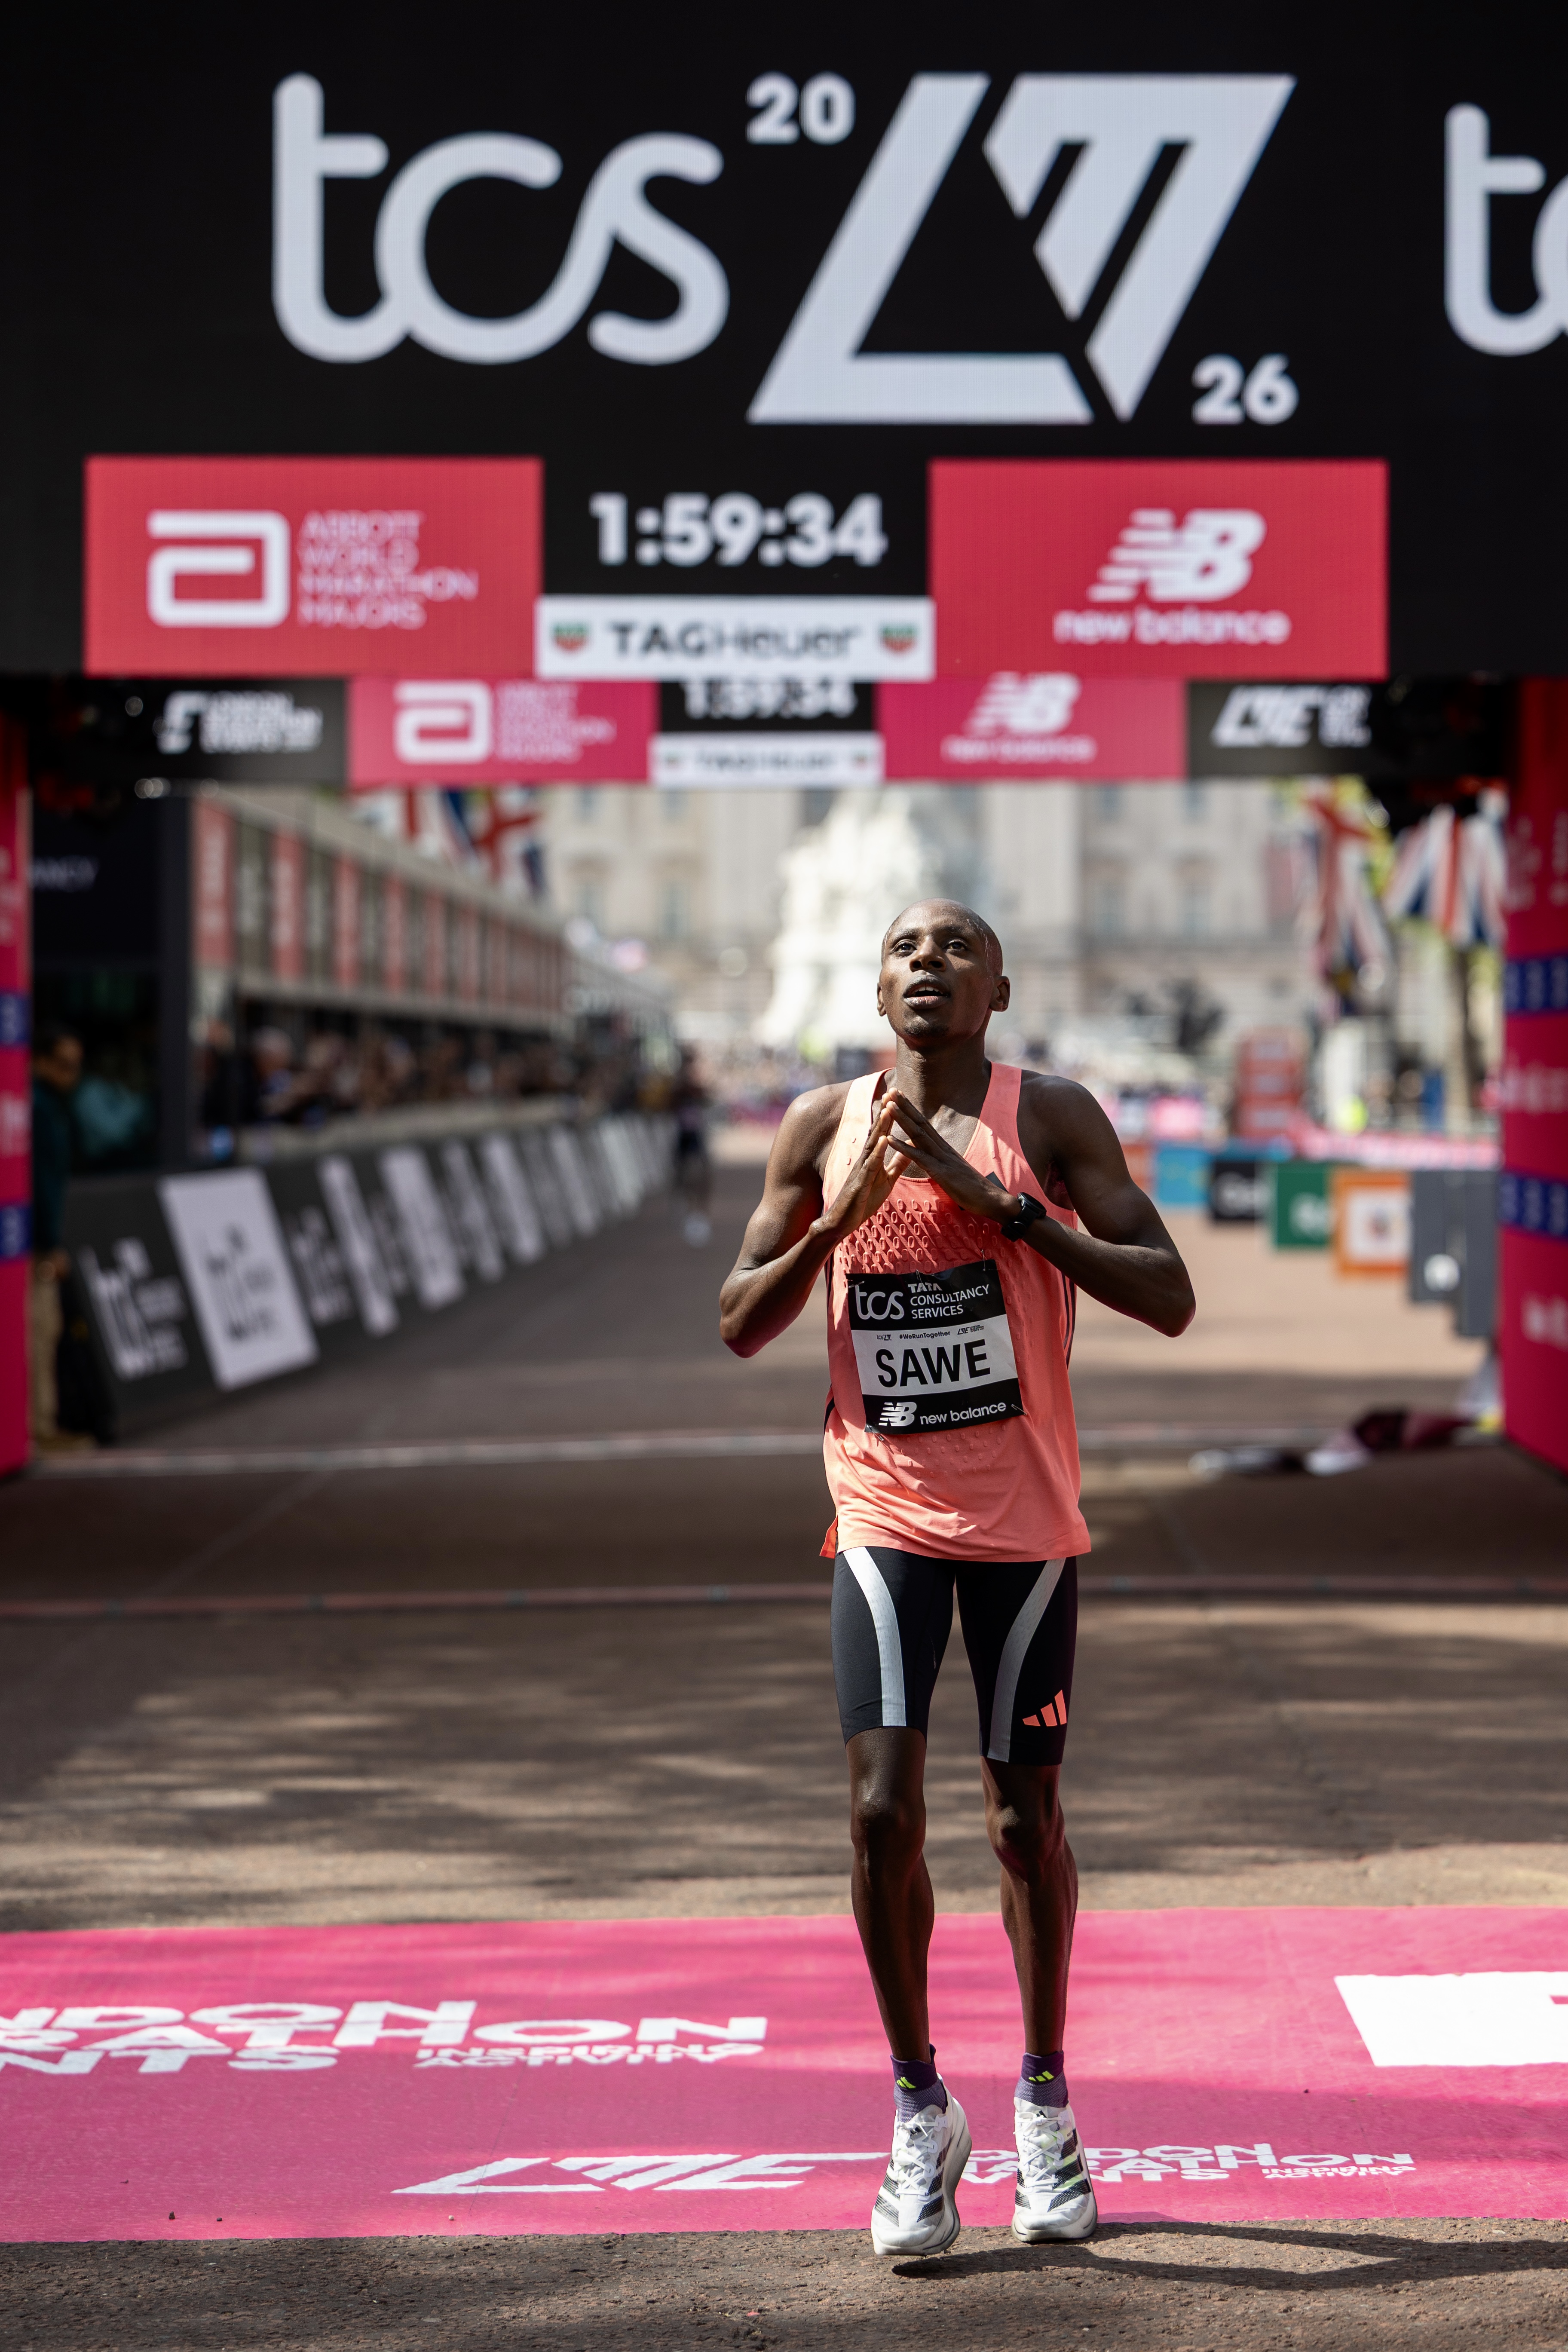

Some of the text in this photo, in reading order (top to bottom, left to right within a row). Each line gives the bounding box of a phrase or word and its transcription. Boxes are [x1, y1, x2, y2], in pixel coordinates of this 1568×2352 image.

[746, 75, 854, 145] 20
[273, 73, 730, 364] tcs
[1443, 103, 1568, 356] t
[1192, 355, 1298, 425] 26
[299, 510, 425, 542] ABBOTT
[589, 492, 888, 567] 1:59:34
[297, 538, 420, 573] WORLD
[298, 567, 479, 600] MARATHON
[298, 597, 427, 630] MAJORS
[1054, 608, 1290, 646] new balance
[855, 1285, 904, 1320] tcs
[908, 1283, 942, 1293] TATA
[910, 1284, 989, 1306] CONSULTANCY
[912, 1304, 963, 1320] SERVICES
[899, 1330, 950, 1339] #WeRunTogether
[875, 1339, 990, 1388] SAWE
[920, 1402, 1006, 1425] new balance
[415, 2043, 765, 2059] INSPIRING
